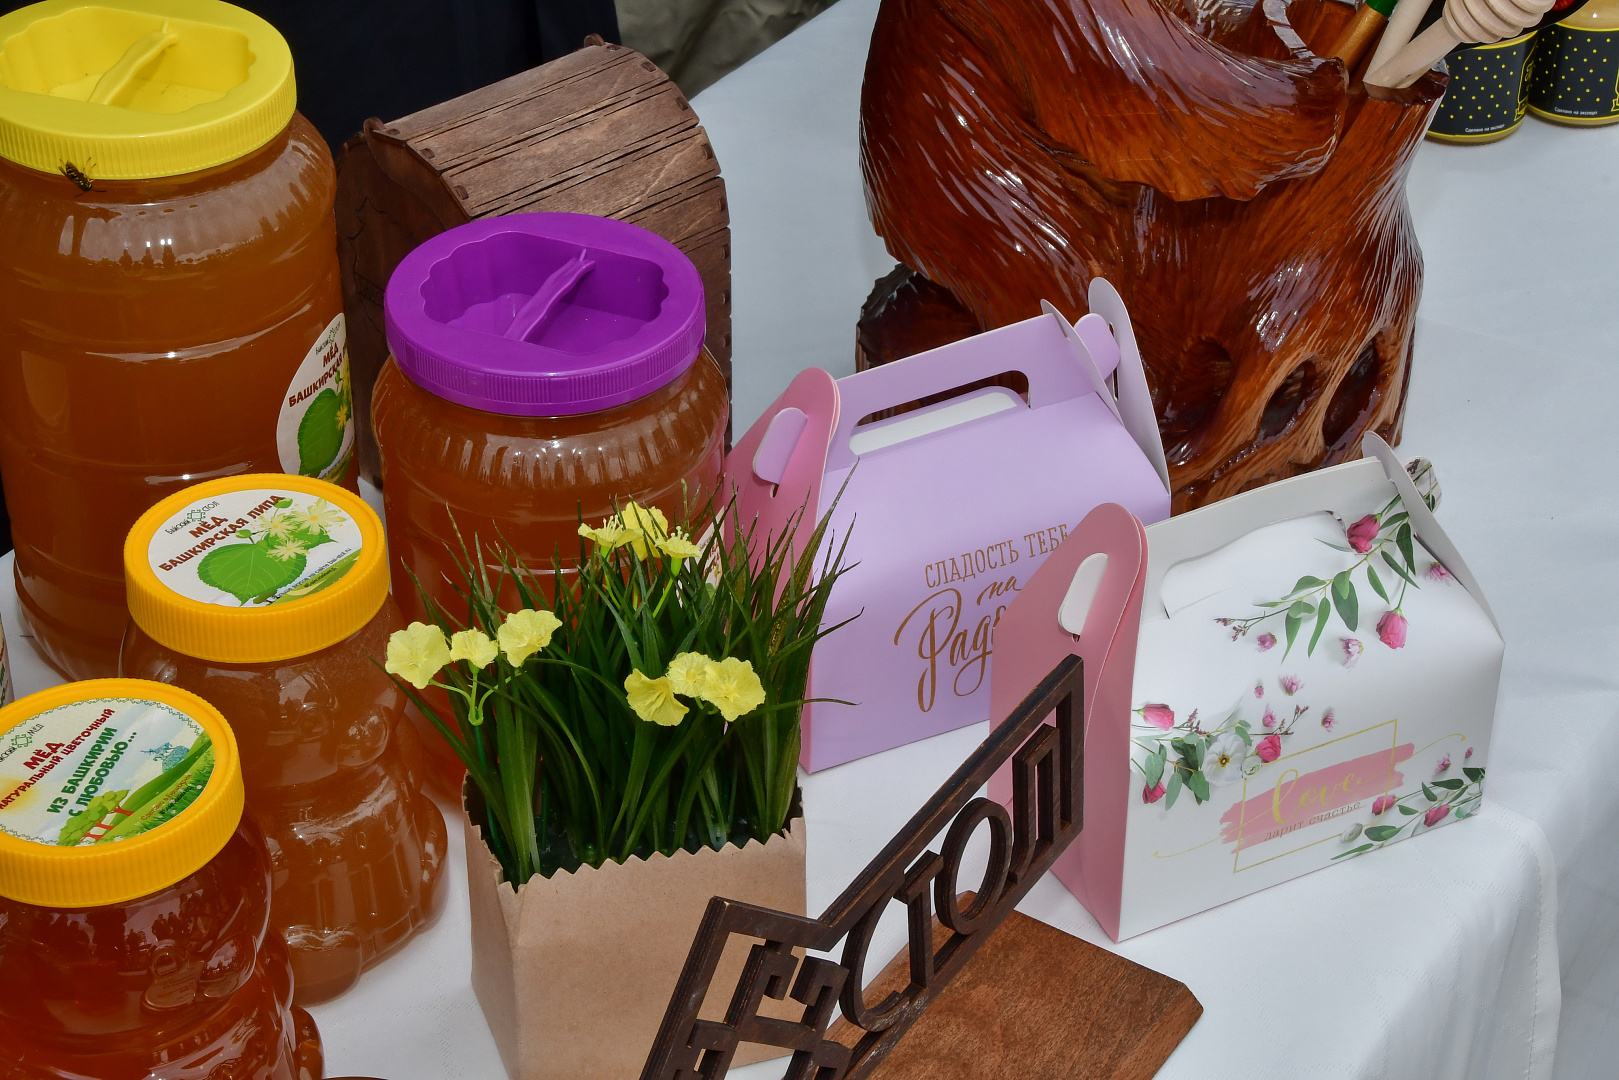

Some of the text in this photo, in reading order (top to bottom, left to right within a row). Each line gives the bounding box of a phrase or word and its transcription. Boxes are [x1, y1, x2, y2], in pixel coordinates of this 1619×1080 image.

[323, 342, 339, 367] МЁД
[288, 353, 343, 407] БАШКИРСКАЯ
[158, 495, 285, 572] БАШКИРСКАЯ ЛИПА
[188, 515, 229, 539] МЁД
[925, 540, 1019, 588] СЛАДОСТЬ
[976, 576, 1021, 606] на
[894, 588, 1006, 712] Рад
[23, 741, 65, 770] МЁД
[61, 708, 115, 760] ЦВЕТОЧНЫЙ
[47, 727, 118, 814] ИЗ БАШКИРИИ
[1264, 802, 1361, 841] дарит счастье
[839, 722, 1061, 1032] СТОЛ
